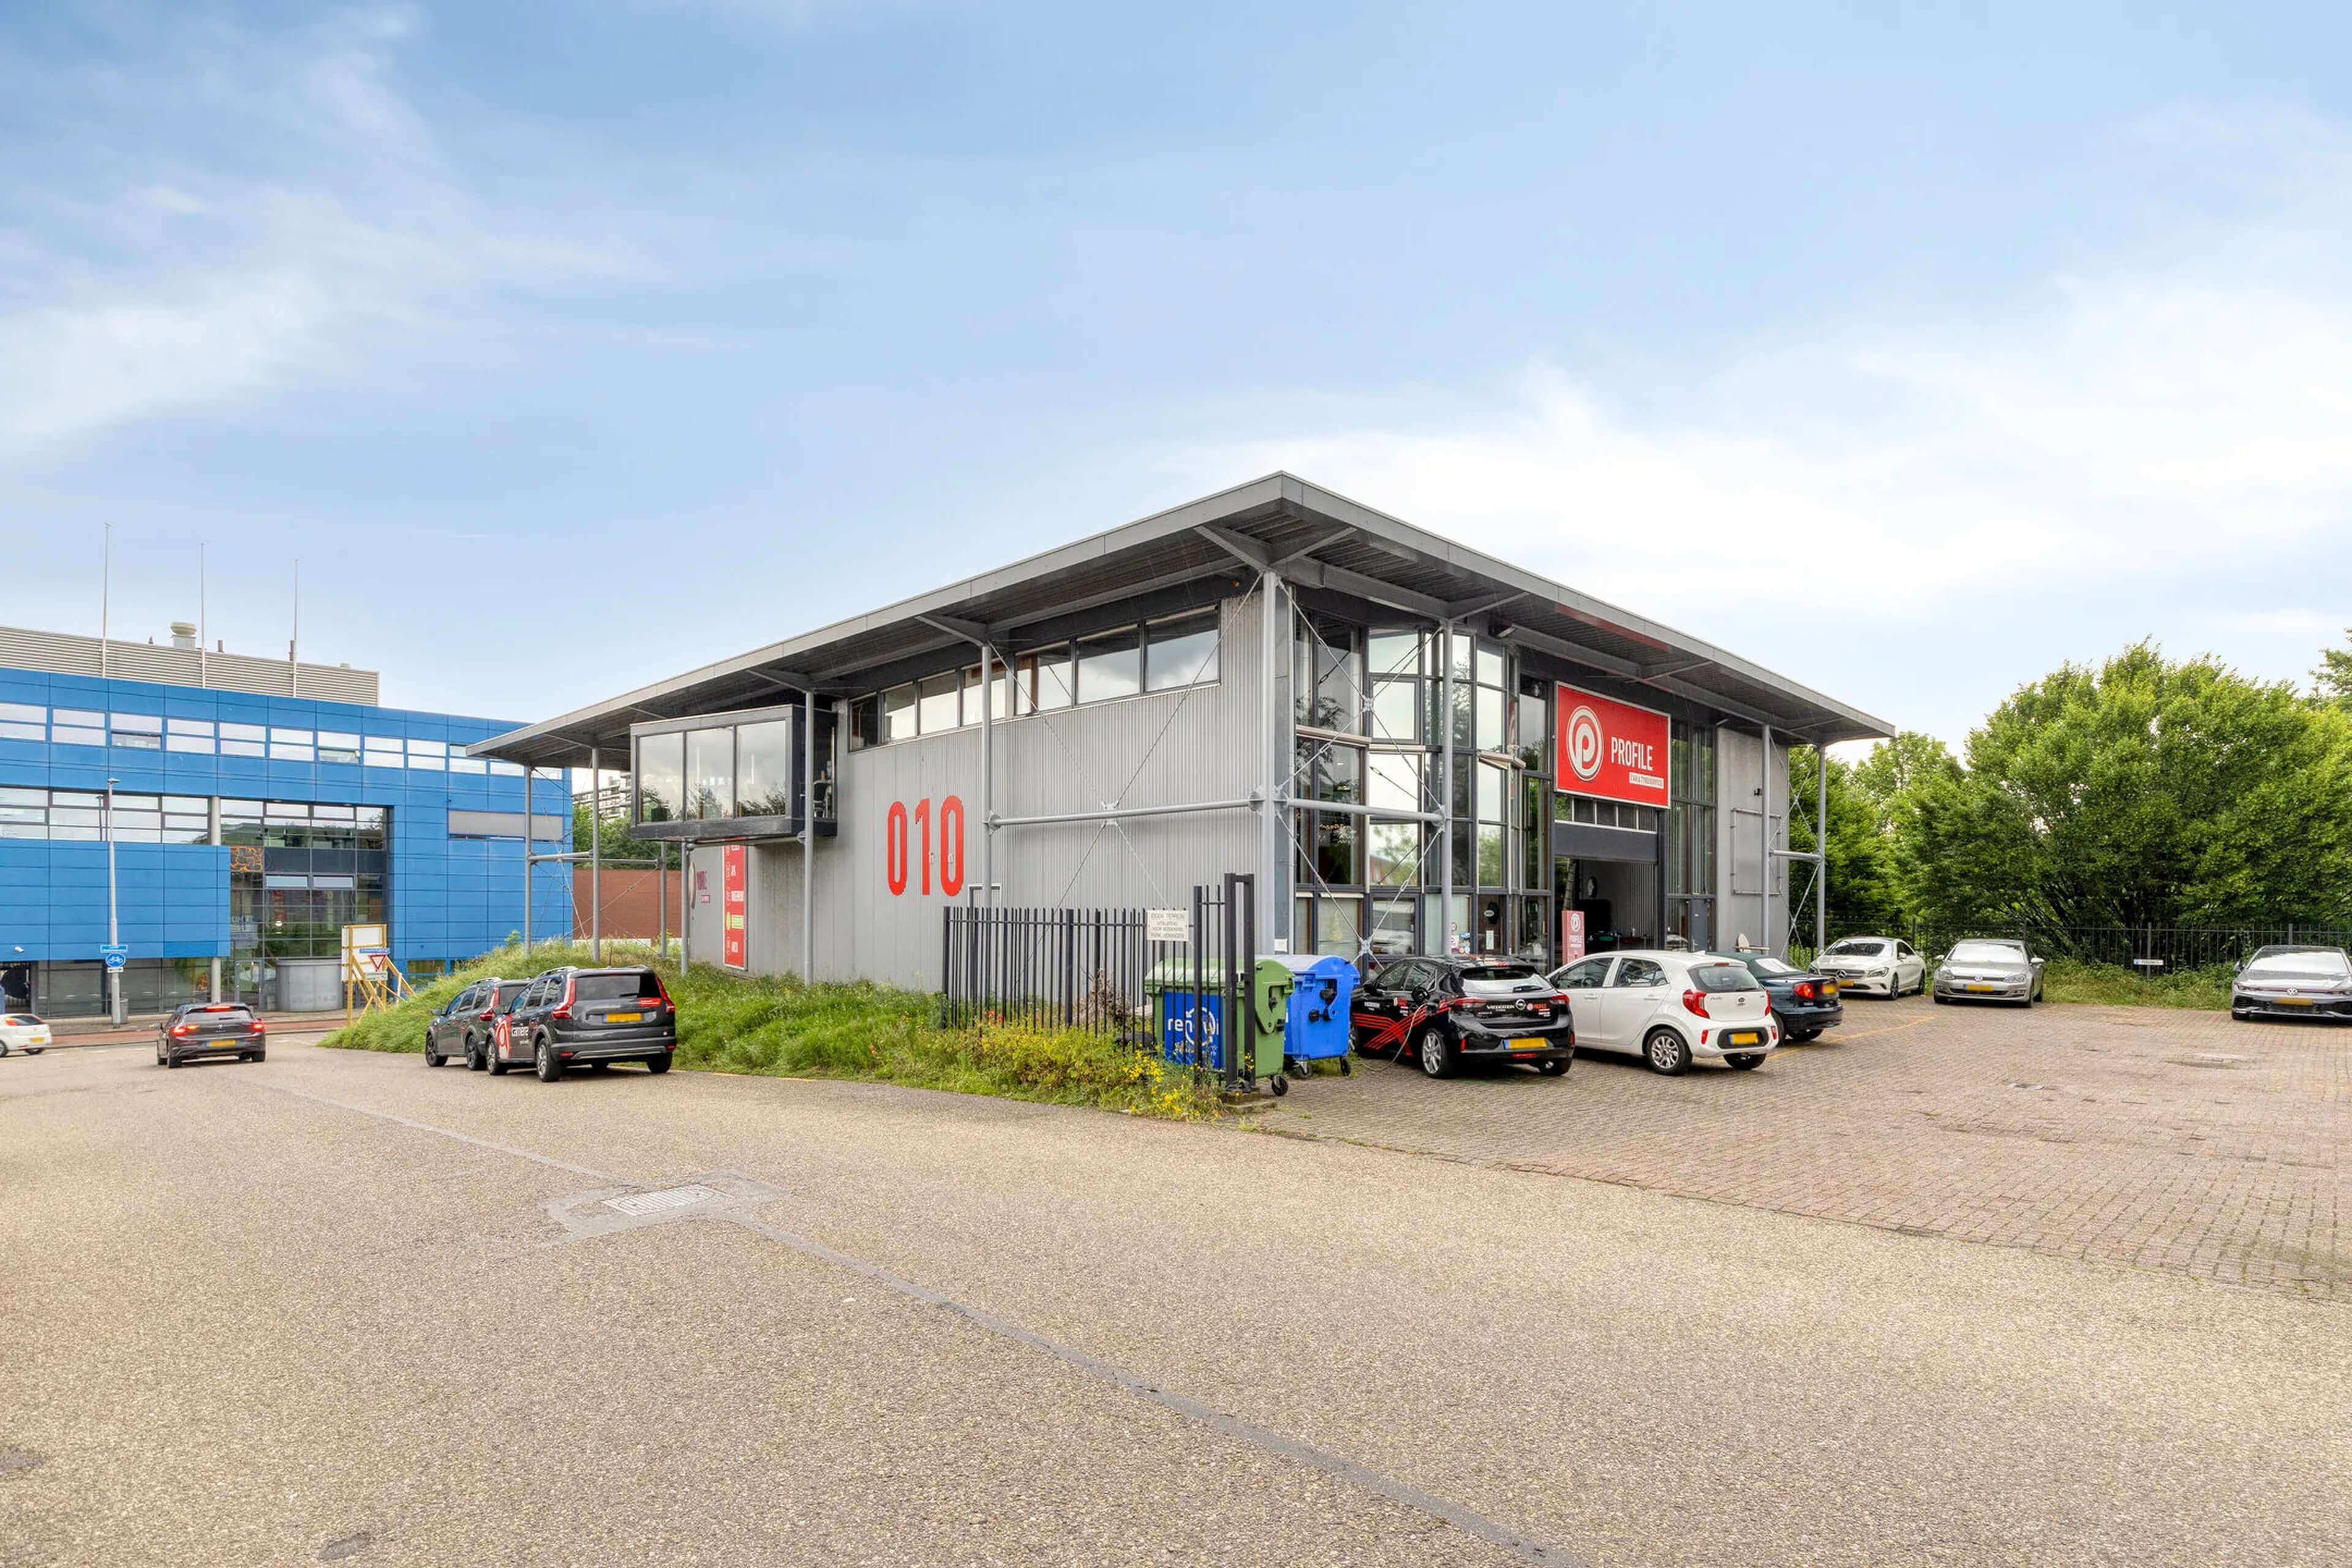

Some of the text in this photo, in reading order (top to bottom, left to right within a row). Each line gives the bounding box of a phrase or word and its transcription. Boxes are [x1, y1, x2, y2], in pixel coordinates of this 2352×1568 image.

[1611, 737, 1653, 771] PROFILE
[888, 795, 963, 897] 010
[1167, 1018, 1219, 1035] renwi
